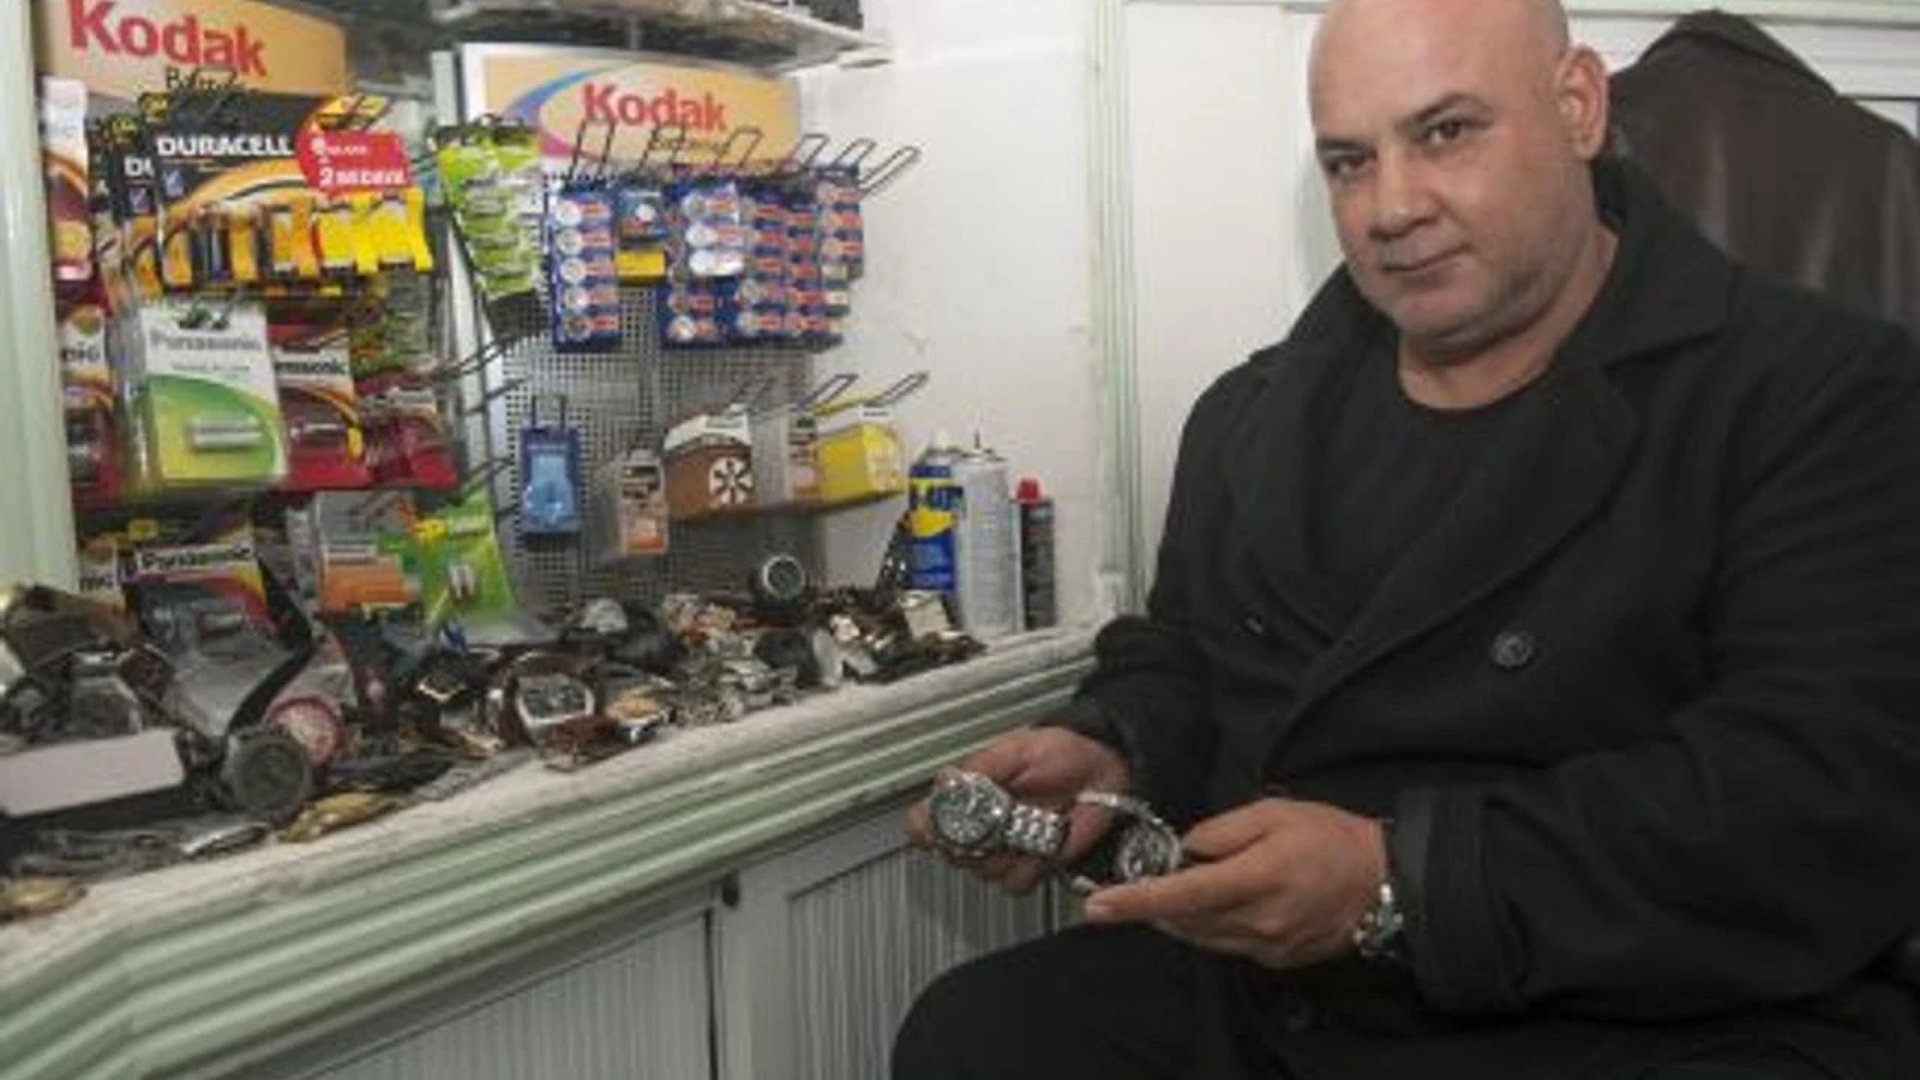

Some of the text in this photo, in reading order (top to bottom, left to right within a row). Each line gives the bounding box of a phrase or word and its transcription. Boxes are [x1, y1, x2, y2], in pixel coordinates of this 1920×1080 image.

[69, 0, 267, 77] Kodak
[583, 83, 729, 132] Kodak
[157, 134, 294, 156] DURACELL
